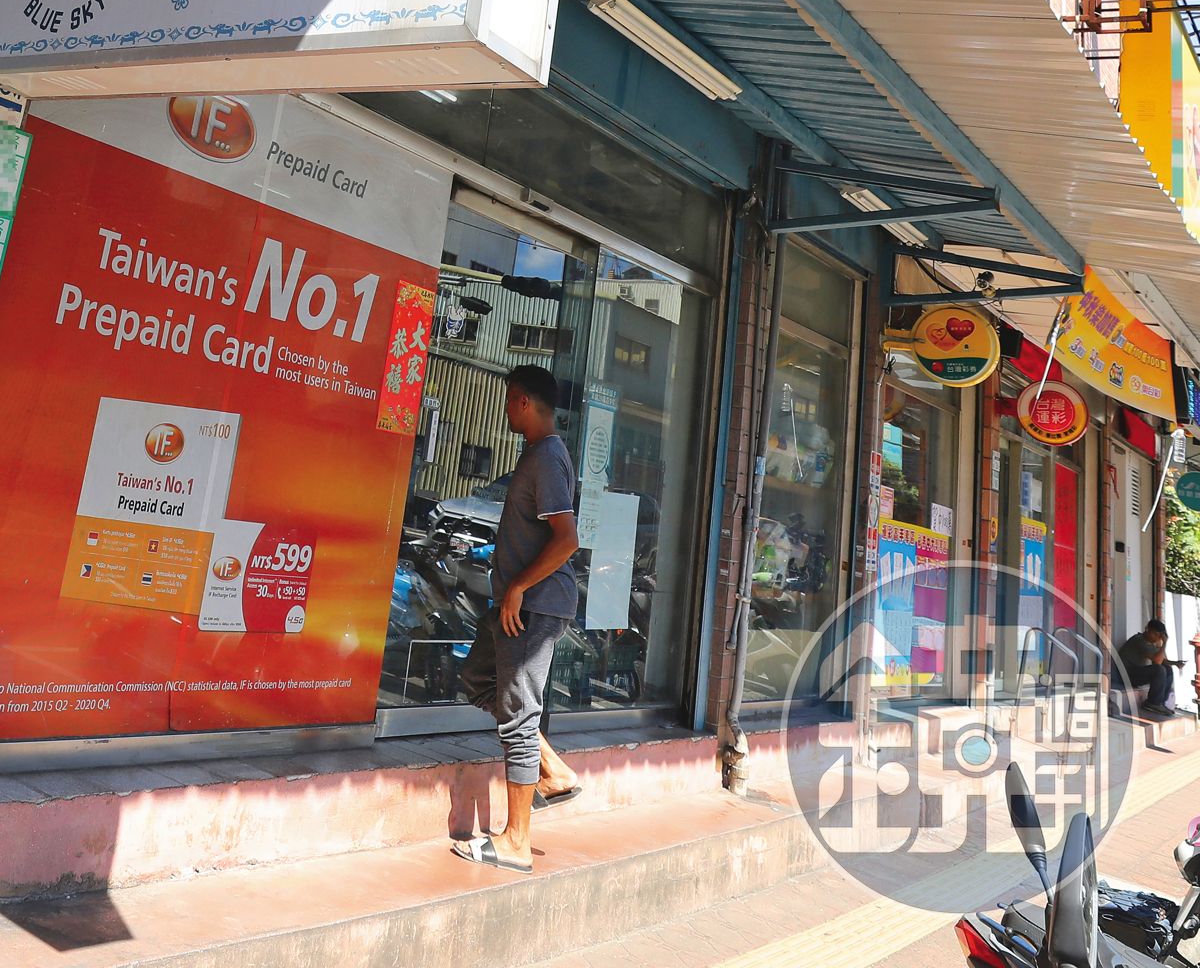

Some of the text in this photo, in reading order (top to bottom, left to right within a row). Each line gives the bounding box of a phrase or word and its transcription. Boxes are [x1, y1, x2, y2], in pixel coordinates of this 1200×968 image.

[266, 141, 368, 198] Prepaid Card
[98, 227, 380, 344] Taiwan's No.1
[55, 282, 275, 375] Prepaid Card
[277, 346, 349, 376] Chosen by the
[406, 320, 427, 385] 大家
[275, 367, 377, 400] most users in Taiwan
[199, 423, 231, 440] NT$100
[117, 472, 194, 496] Taiwan's No.1
[117, 495, 185, 517] Prepaid Card
[250, 542, 313, 573] NT$599
[256, 585, 268, 598] 30
[6, 682, 45, 694] National
[46, 681, 114, 693] Communication
[115, 680, 163, 692] Commission
[164, 680, 186, 692] (NCC)
[187, 680, 221, 691] statistical
[221, 679, 238, 691] data,
[239, 680, 247, 690] IF
[247, 680, 253, 690] is
[254, 679, 277, 690] chosen
[278, 679, 287, 691] by
[287, 679, 298, 689] the
[298, 680, 315, 689] most
[314, 678, 338, 690] prepaid
[338, 678, 352, 688] card
[7, 701, 29, 712] from
[31, 700, 53, 712] 2015
[55, 699, 68, 712] Q2
[74, 699, 96, 711] 2020
[97, 698, 111, 711] Q4.
